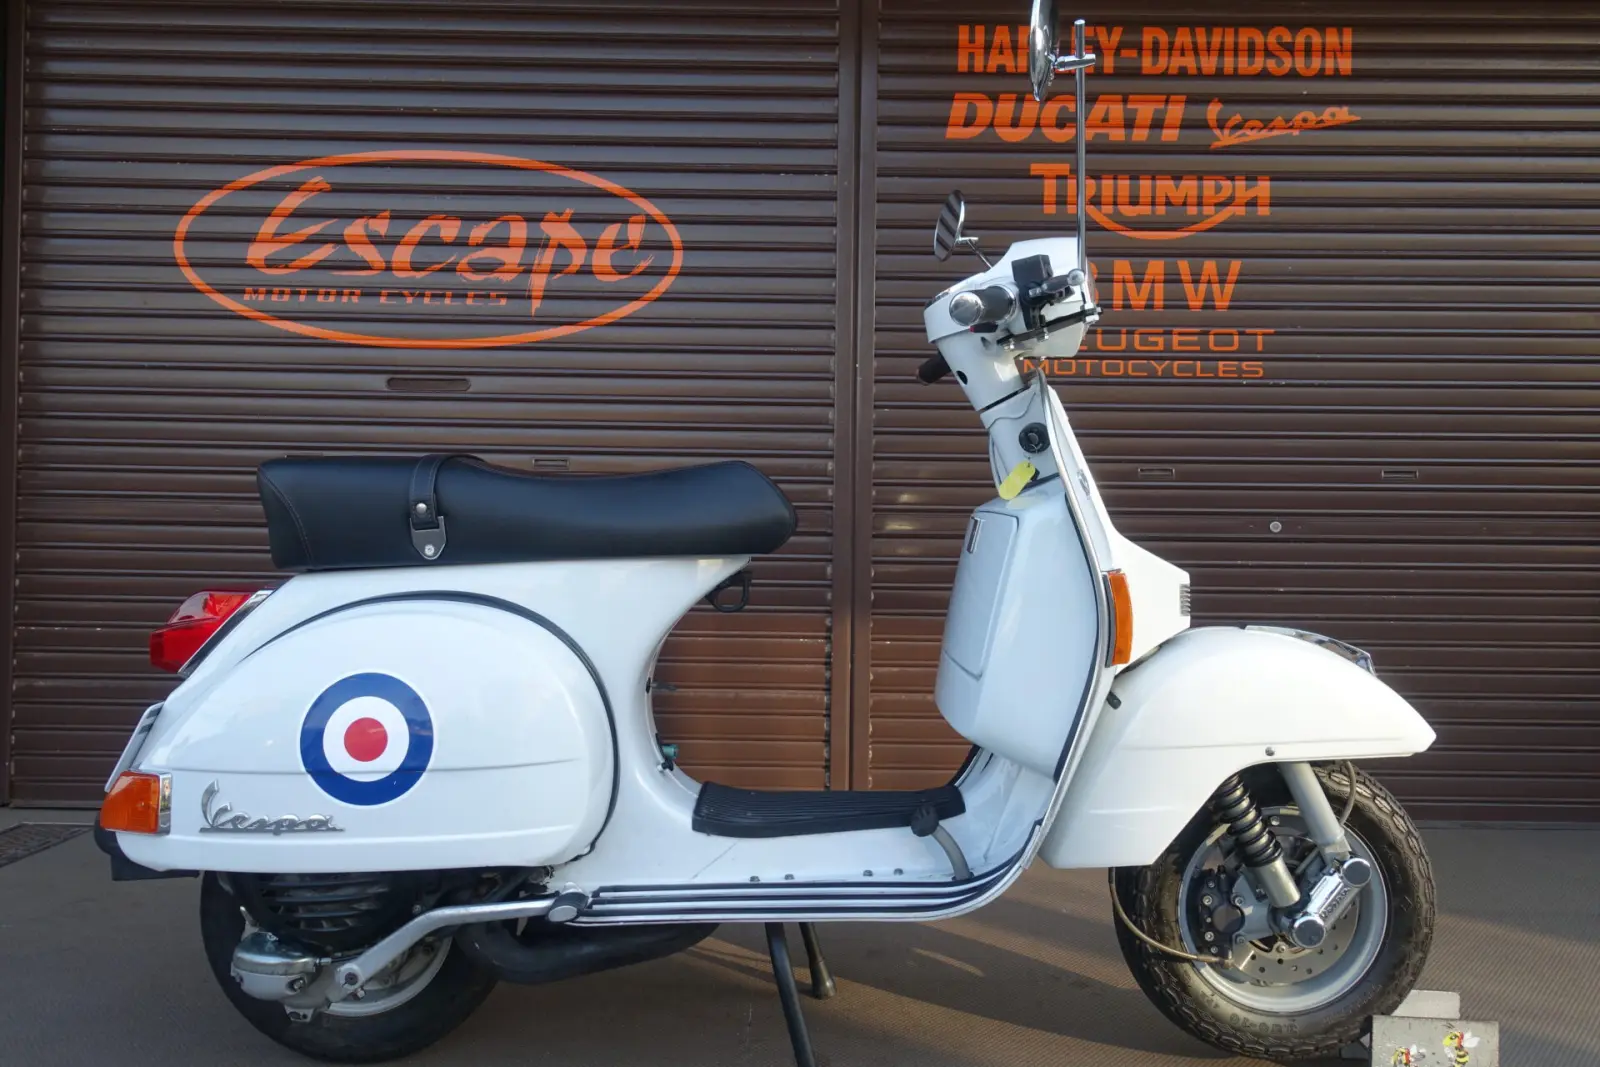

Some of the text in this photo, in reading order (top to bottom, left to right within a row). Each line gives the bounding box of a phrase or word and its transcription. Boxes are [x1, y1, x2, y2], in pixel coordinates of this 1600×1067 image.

[957, 25, 1353, 76] HAEY-DAVIDSON
[945, 93, 1361, 149] DUCATI Vespa
[245, 176, 654, 318] Escape
[243, 287, 508, 306] MOTOR CYCLES
[1080, 329, 1275, 352] UGEOT
[1023, 359, 1264, 378] MOTOCYCLES
[199, 779, 345, 835] Vespa
